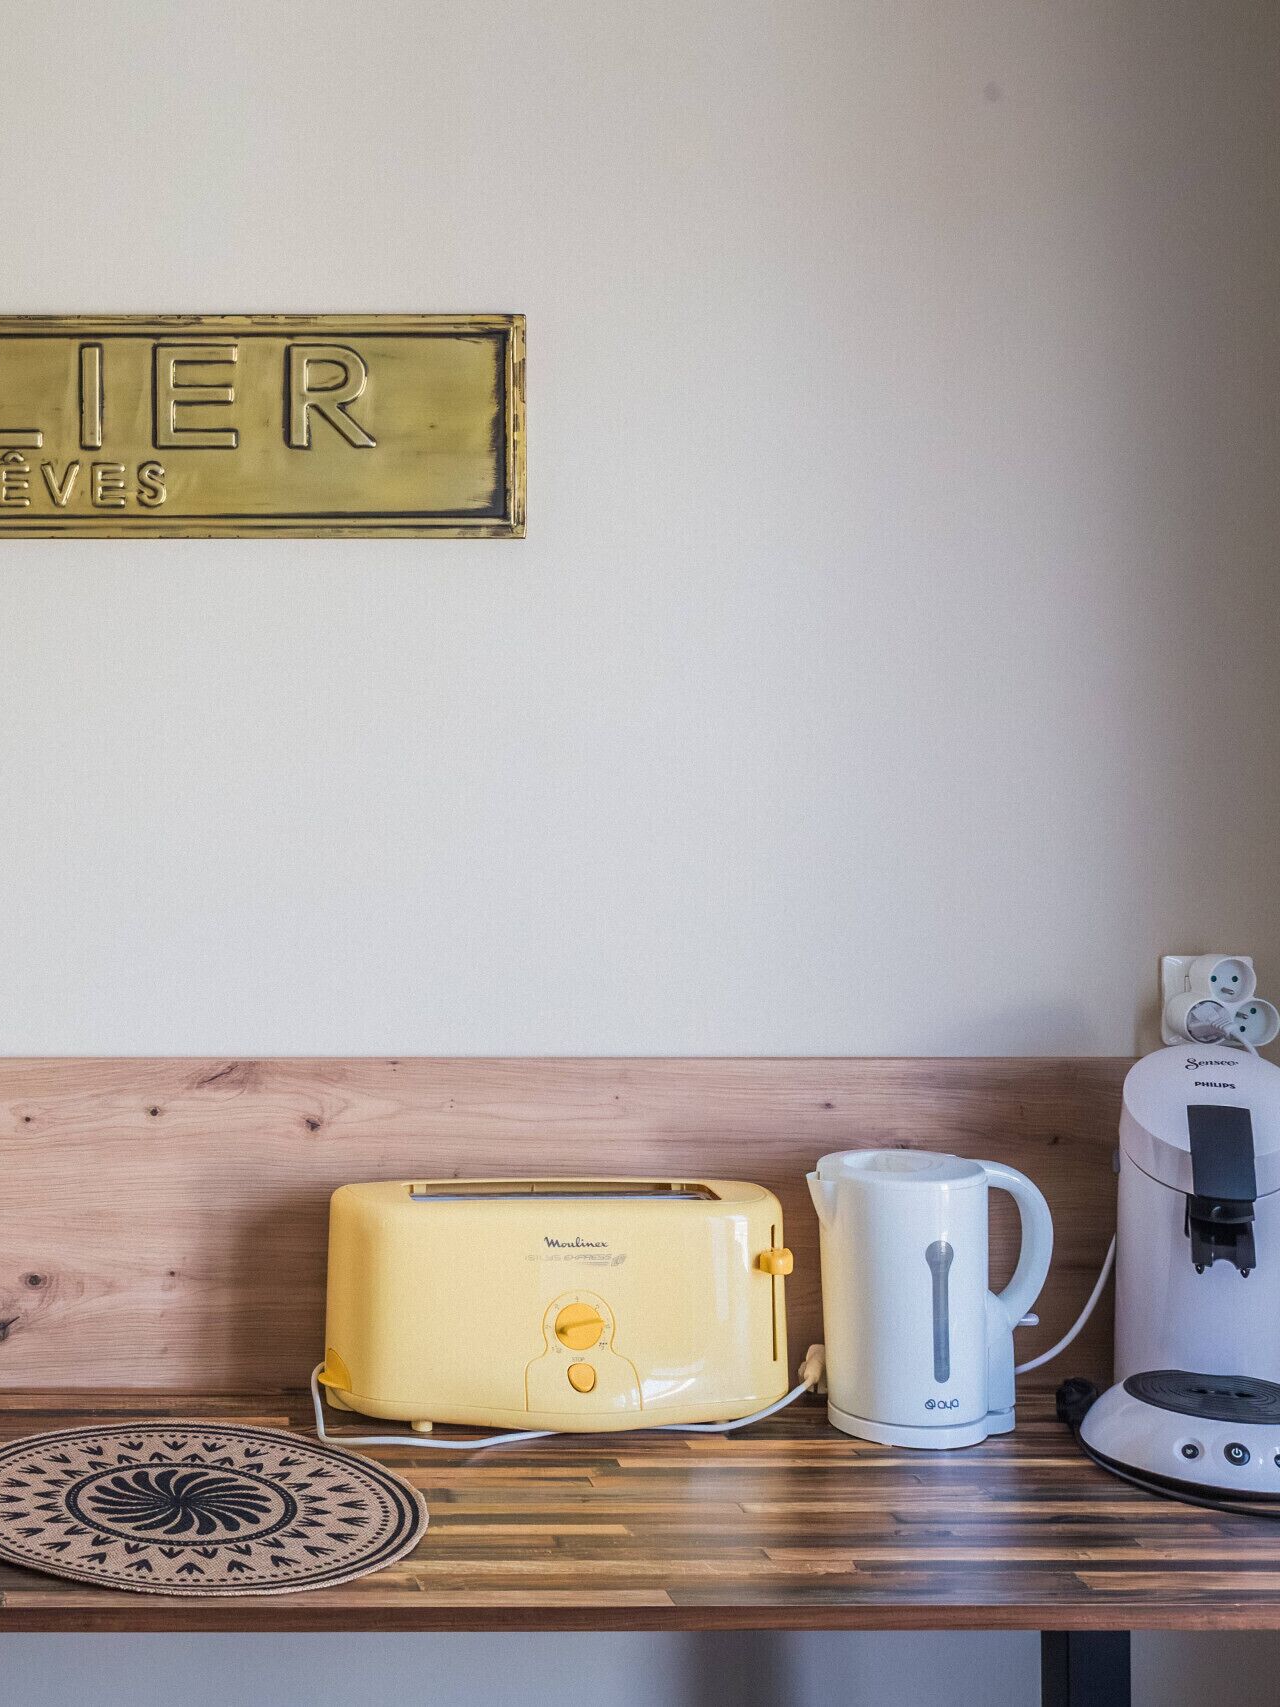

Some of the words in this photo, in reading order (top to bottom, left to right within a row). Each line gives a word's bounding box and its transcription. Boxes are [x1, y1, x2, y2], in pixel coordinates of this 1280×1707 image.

[1185, 1057, 1236, 1070] Senseo
[1194, 1081, 1236, 1090] PHILIPS
[543, 1236, 609, 1248] Moulinex
[937, 1398, 960, 1411] aya
